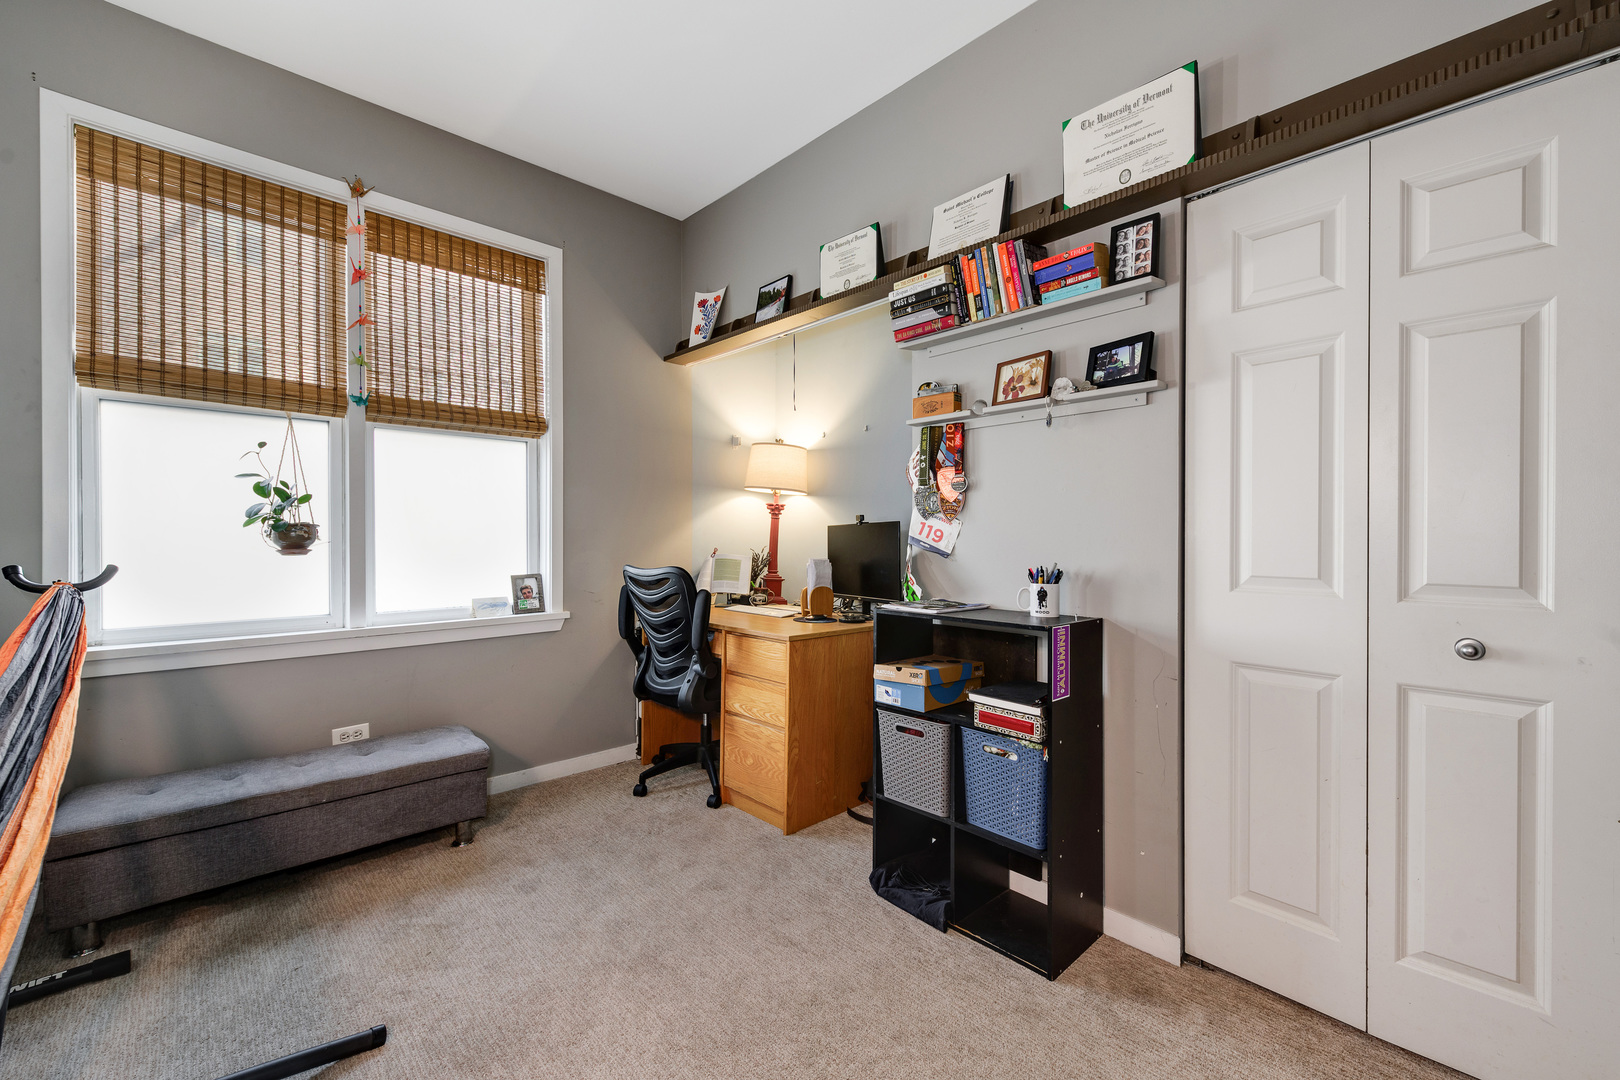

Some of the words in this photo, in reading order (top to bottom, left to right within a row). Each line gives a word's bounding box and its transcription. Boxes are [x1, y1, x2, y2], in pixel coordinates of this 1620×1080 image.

[1080, 119, 1095, 131] The
[1096, 103, 1132, 124] University
[1132, 97, 1141, 109] of
[1142, 83, 1173, 105] Vermont
[1104, 128, 1123, 139] Nicholas
[1106, 145, 1123, 155] Science
[1128, 135, 1147, 146] Medical
[1147, 128, 1165, 138] Science
[977, 188, 994, 199] College
[893, 298, 907, 308] JUST
[908, 295, 916, 303] US
[918, 521, 944, 543] 119
